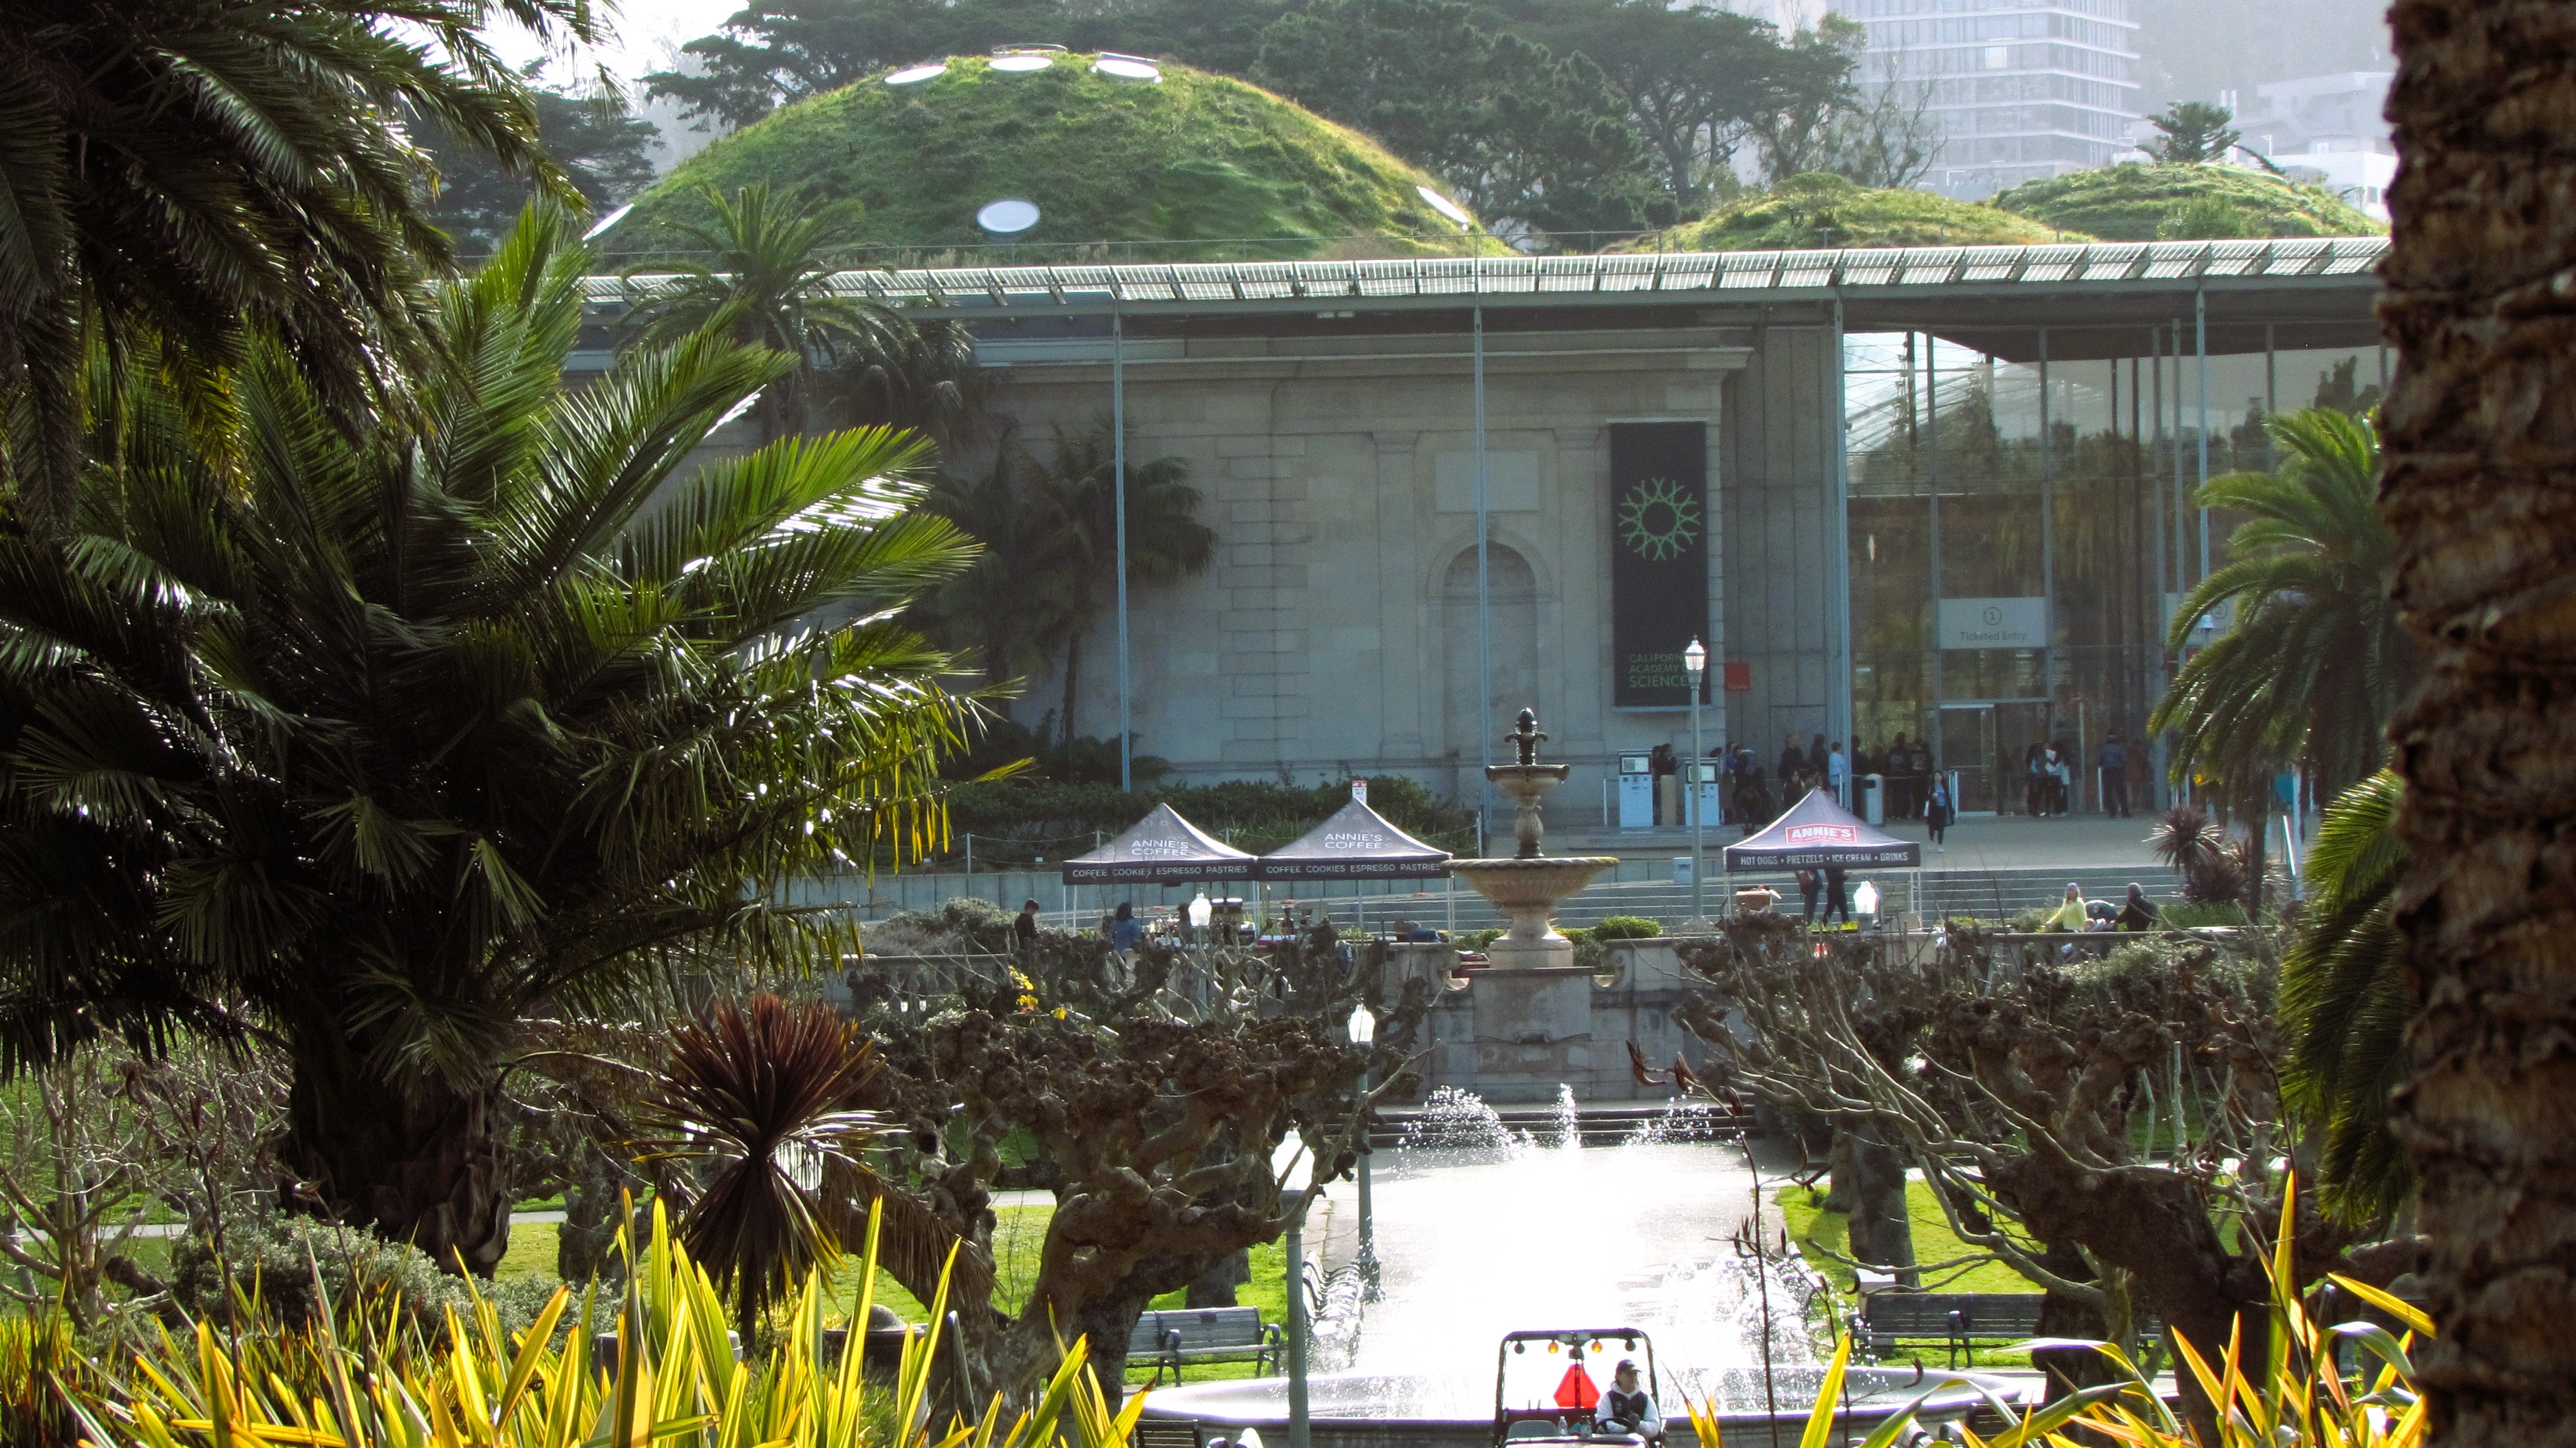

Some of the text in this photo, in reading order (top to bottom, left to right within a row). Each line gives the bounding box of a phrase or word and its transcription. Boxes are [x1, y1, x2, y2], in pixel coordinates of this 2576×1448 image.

[1960, 631, 2025, 641] Ticketed Entry
[1629, 653, 1684, 663] CALIFORN
[1629, 664, 1679, 673] ACADEMY
[1629, 674, 1691, 688] SCIENCE
[1324, 833, 1383, 842] ANNIE'S
[1792, 827, 1852, 839] ANNIE'S
[1131, 840, 1189, 849] ANNIE'S
[1324, 841, 1382, 849] COFFEE
[1131, 848, 1188, 856] COFFEE
[1741, 852, 1908, 865] HOT DOGS PRETZELS ICE CREAM DRINKS
[1072, 869, 1107, 877] COFFEE
[1157, 866, 1201, 875] ESPRESSO
[1206, 864, 1247, 874] PASTRIES
[1266, 865, 1301, 873] COFFEE
[1306, 864, 1346, 873] COOKIES
[1350, 863, 1395, 872] ESPRESSO
